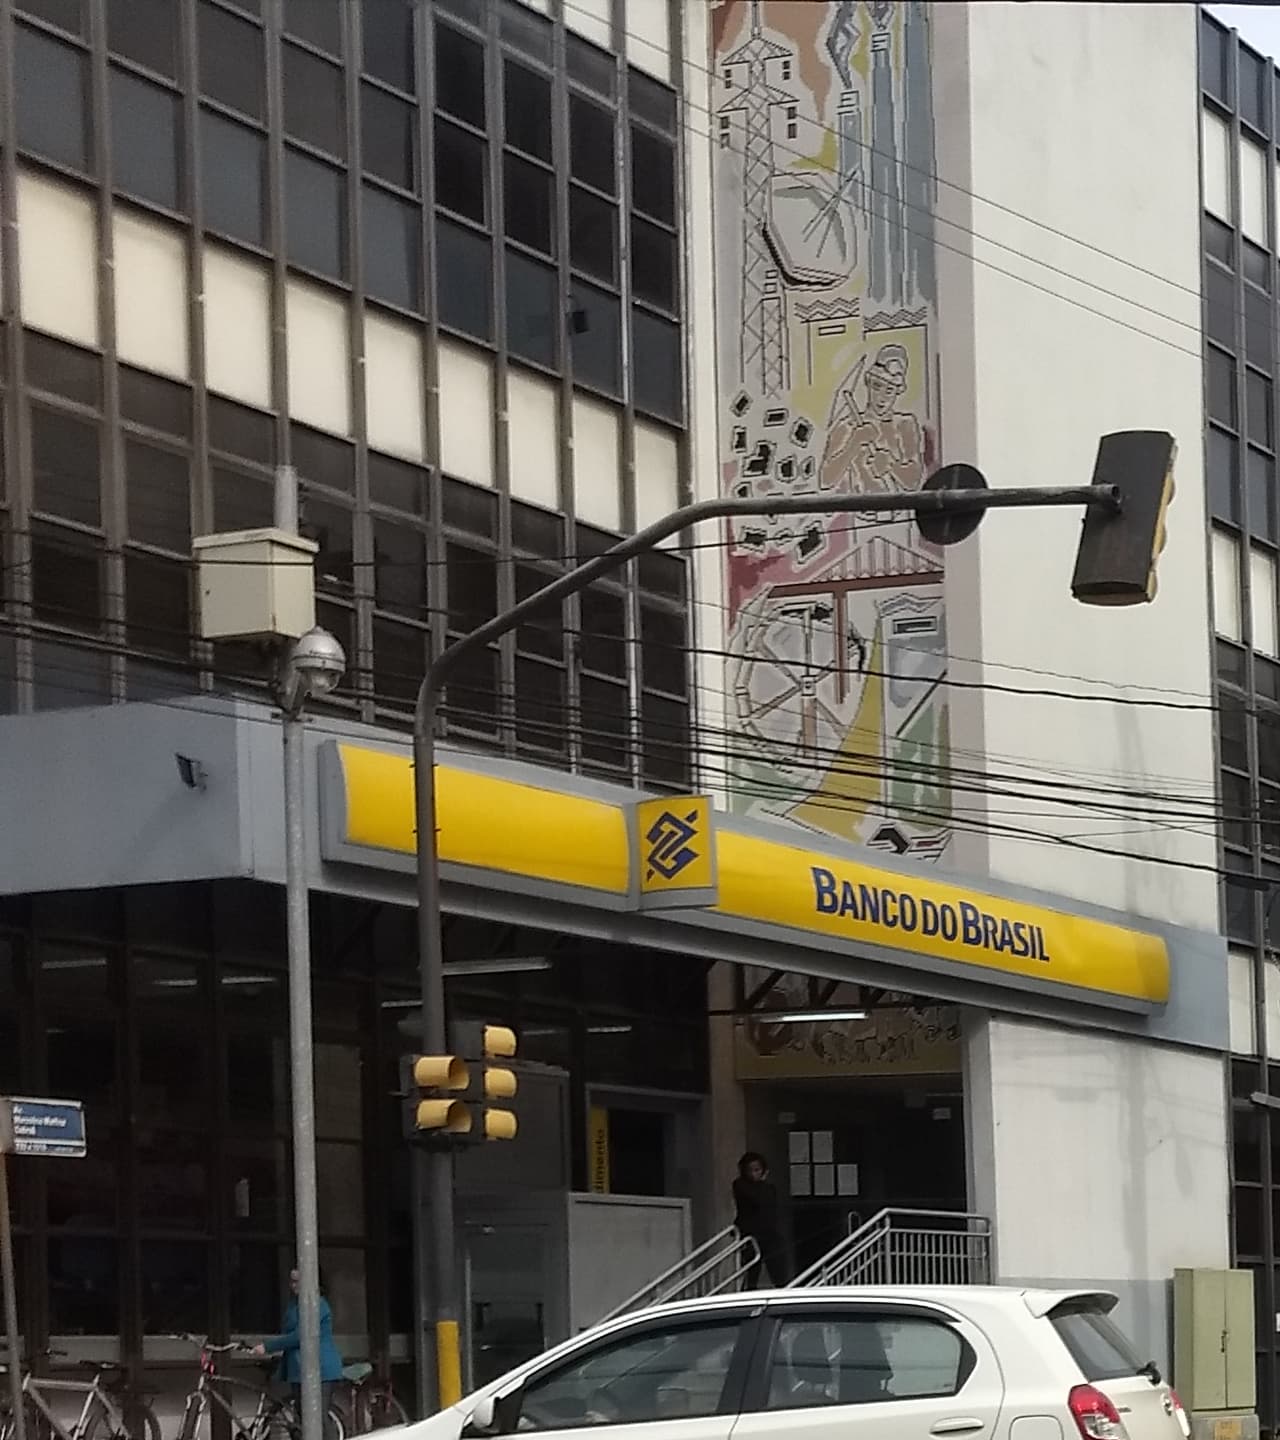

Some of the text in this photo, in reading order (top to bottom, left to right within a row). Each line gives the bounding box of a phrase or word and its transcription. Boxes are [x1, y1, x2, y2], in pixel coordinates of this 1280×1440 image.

[810, 867, 1050, 962] BANCO DO BRASIL
